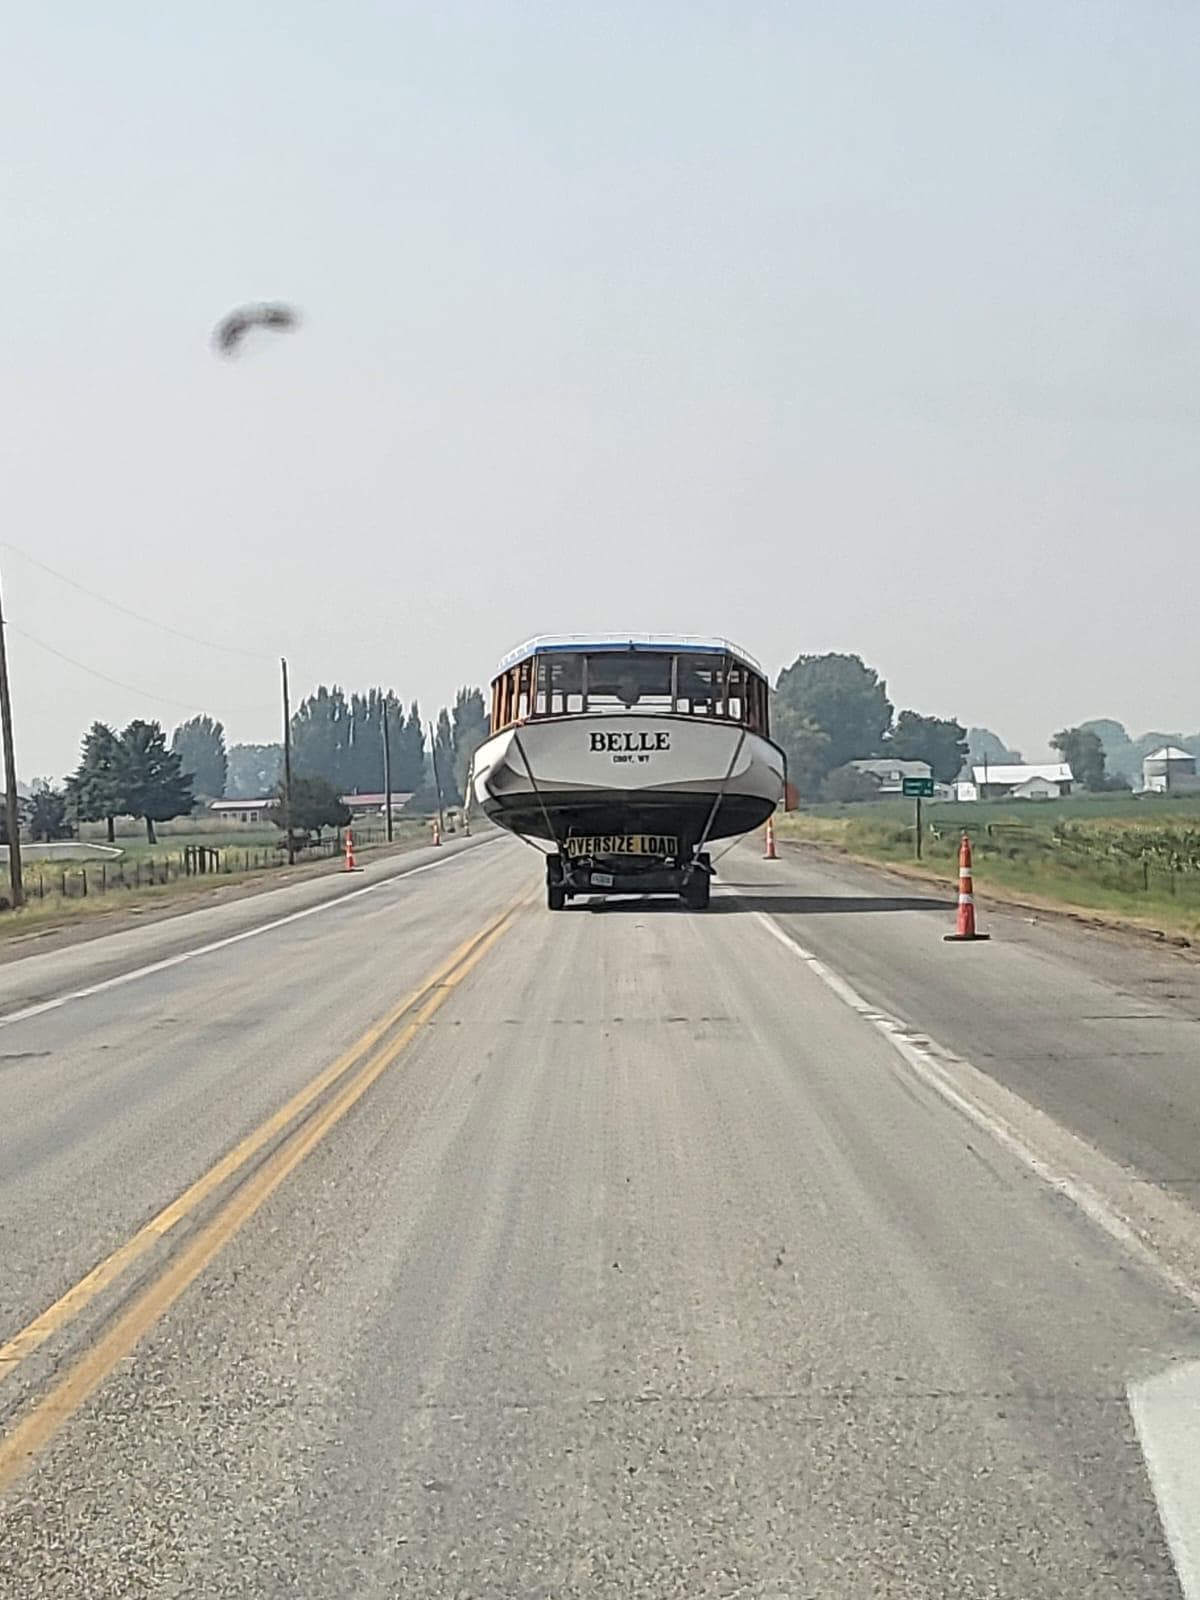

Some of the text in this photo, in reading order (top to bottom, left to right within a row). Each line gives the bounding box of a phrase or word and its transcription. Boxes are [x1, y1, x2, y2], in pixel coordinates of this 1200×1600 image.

[589, 732, 671, 752] BELLE
[567, 836, 677, 856] OVERSIZE LOAD
